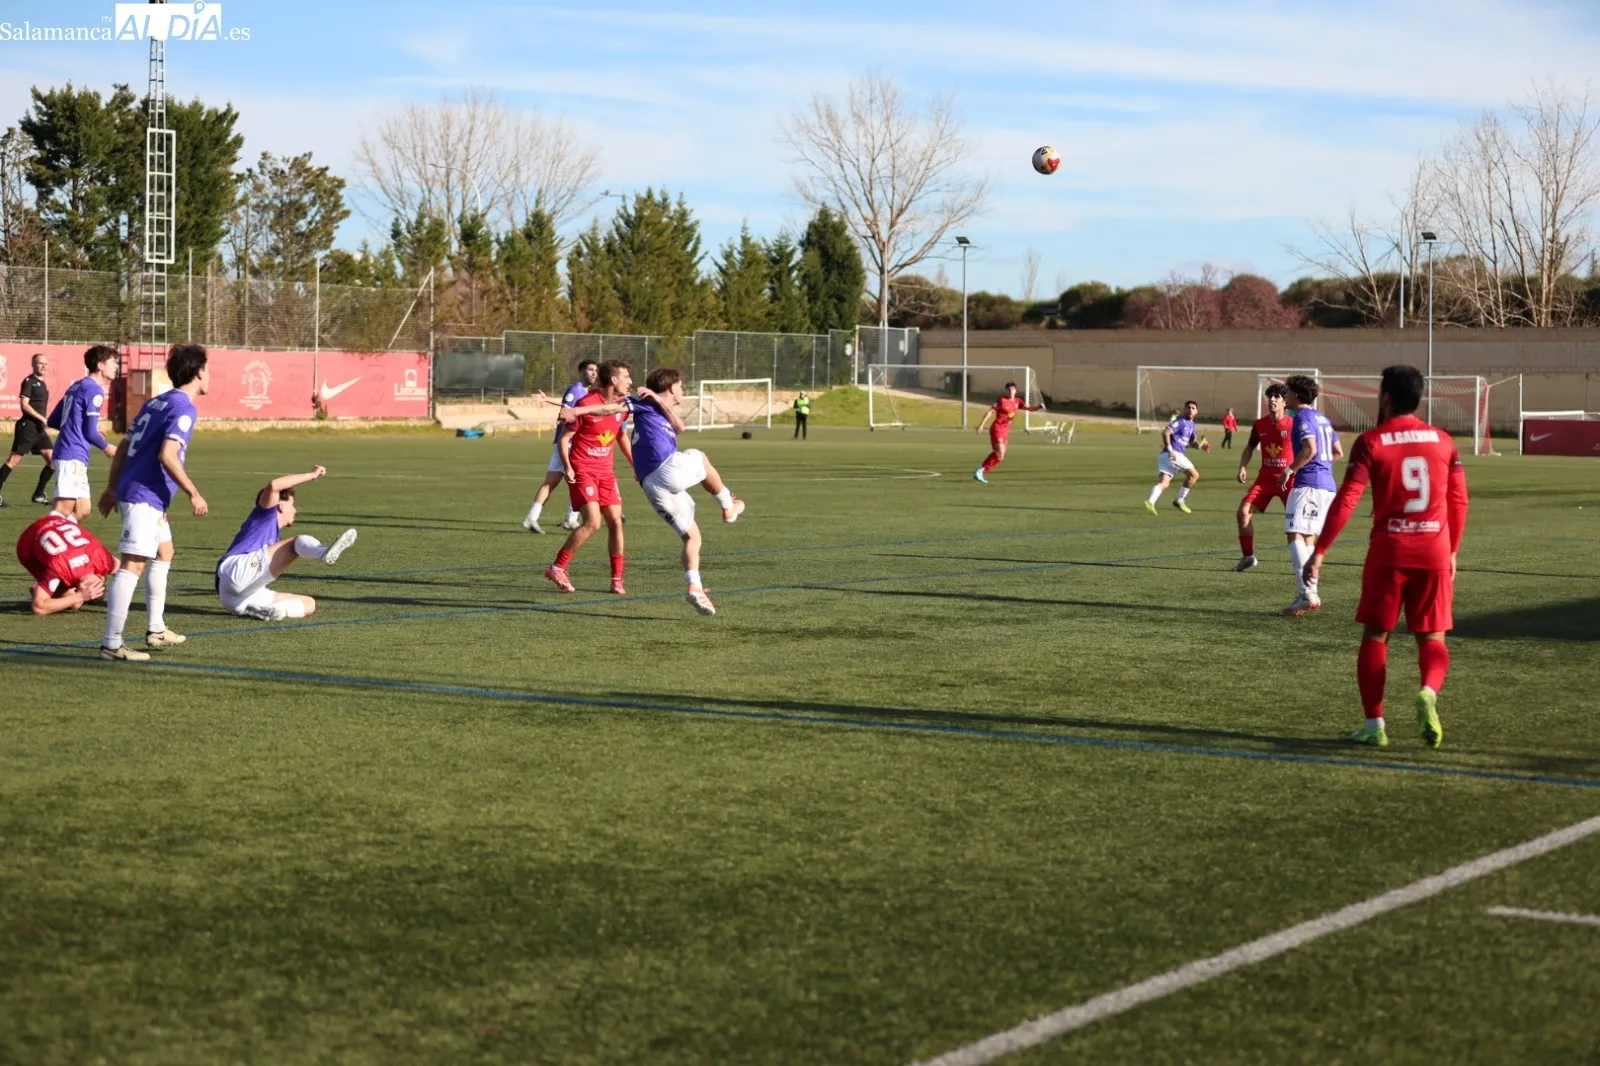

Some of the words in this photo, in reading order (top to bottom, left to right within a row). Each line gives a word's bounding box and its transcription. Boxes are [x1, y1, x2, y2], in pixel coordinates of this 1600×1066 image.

[127, 412, 152, 457] 2
[1401, 455, 1431, 513] 9
[39, 523, 91, 556] 20
